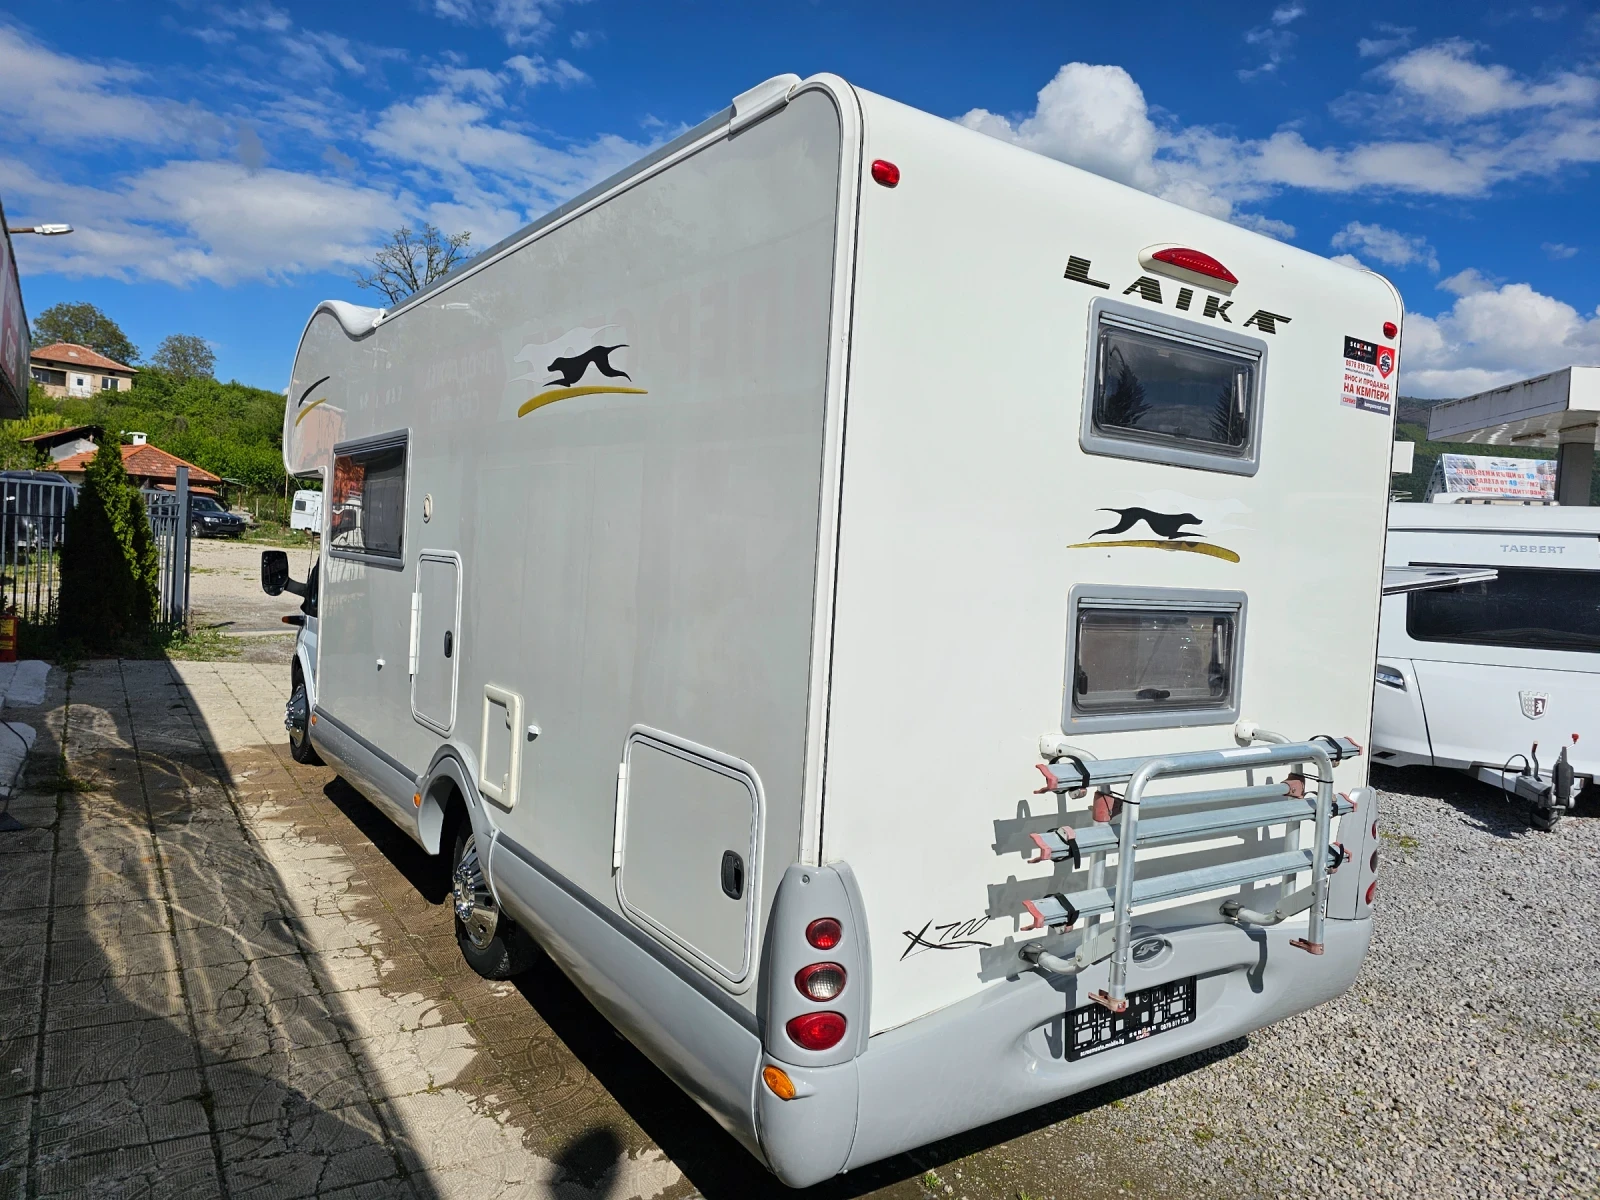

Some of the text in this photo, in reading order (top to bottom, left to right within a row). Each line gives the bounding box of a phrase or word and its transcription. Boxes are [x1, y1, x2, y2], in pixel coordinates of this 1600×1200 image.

[1063, 255, 1293, 335] LAIKA
[1344, 374, 1358, 383] ВНОС
[1363, 378, 1390, 391] ПРОДАЖБА
[1343, 382, 1390, 402] НА КЕМПЕРИ
[1499, 544, 1566, 554] TABBERT
